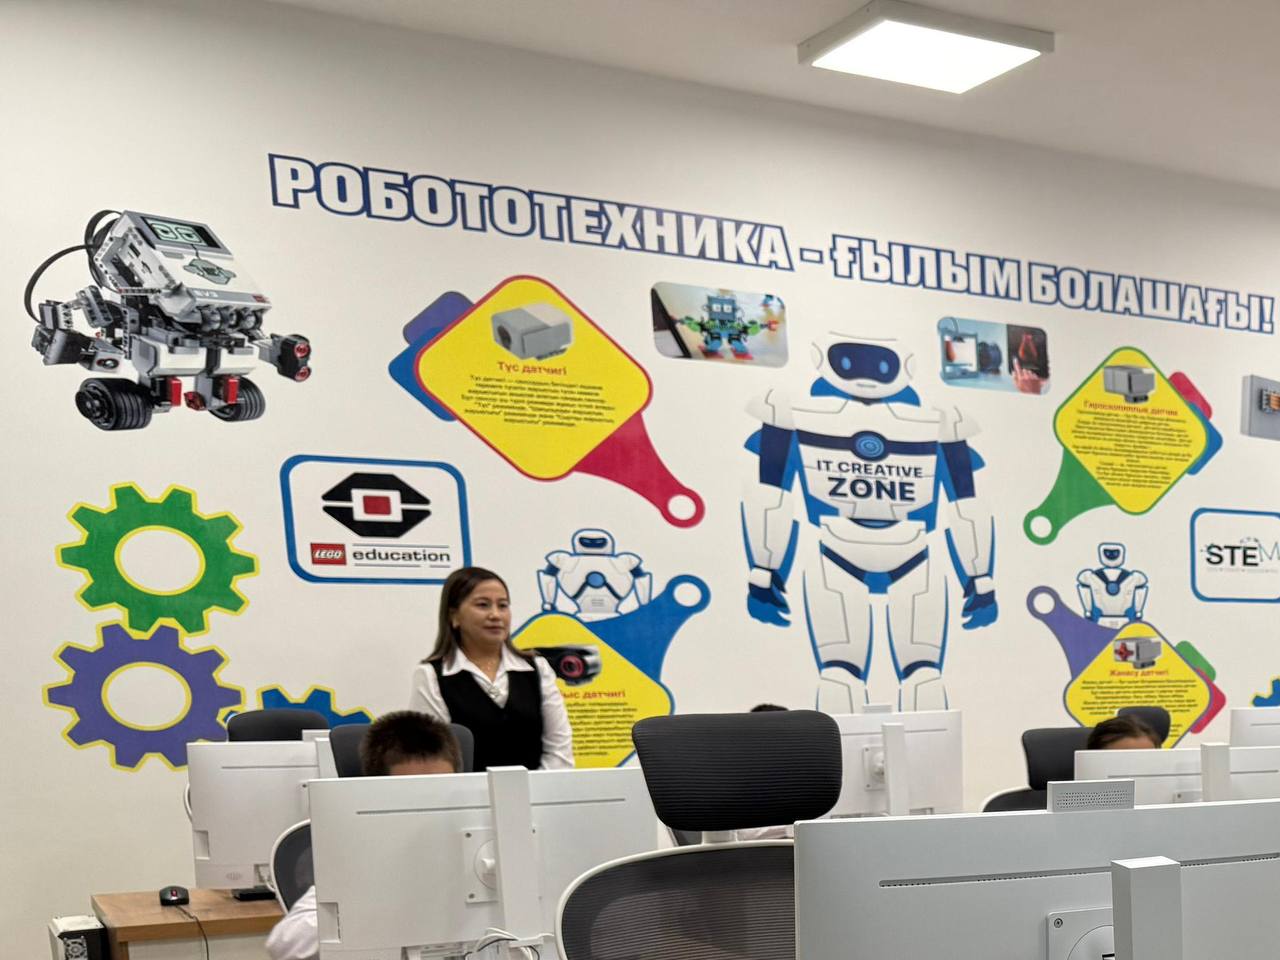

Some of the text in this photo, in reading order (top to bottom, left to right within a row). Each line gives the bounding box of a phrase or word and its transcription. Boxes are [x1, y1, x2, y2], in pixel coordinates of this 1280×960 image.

[268, 153, 795, 271] РОБОТОТЕХНИКА
[817, 460, 923, 478] IT CREATIVE
[828, 477, 916, 502] ZONE
[352, 549, 451, 562] education
